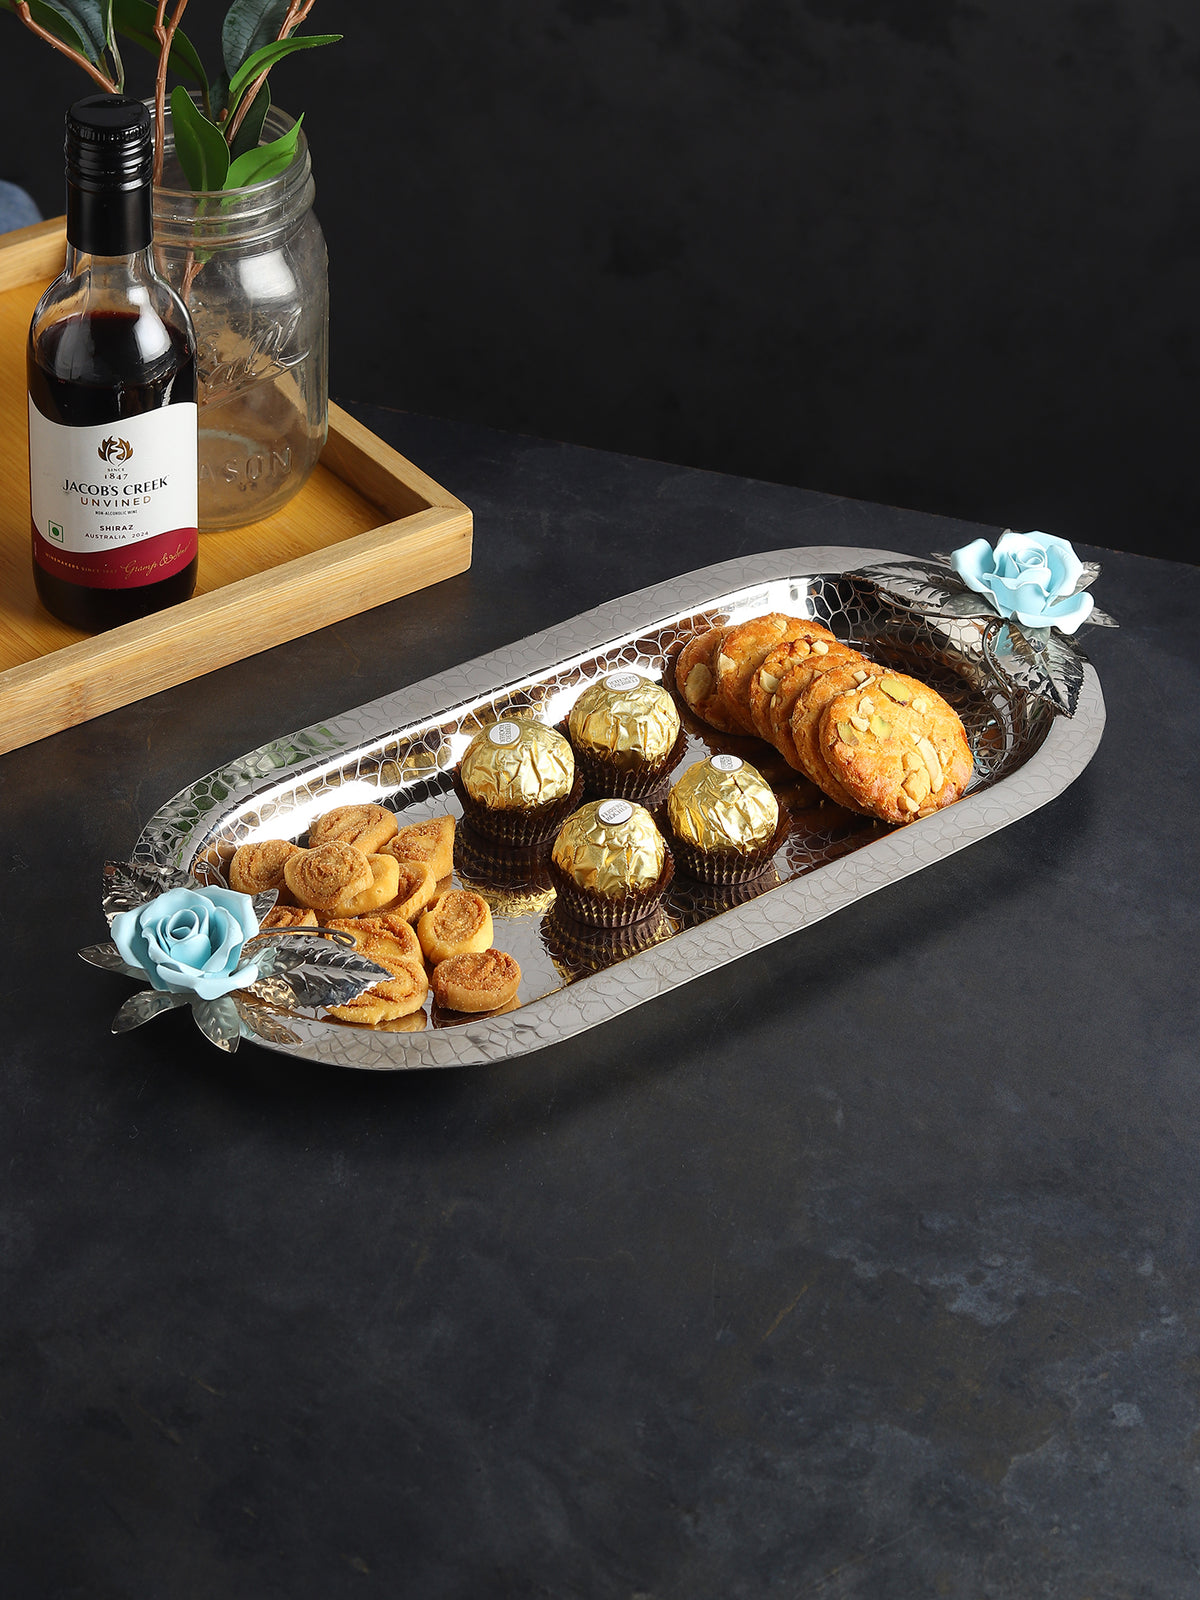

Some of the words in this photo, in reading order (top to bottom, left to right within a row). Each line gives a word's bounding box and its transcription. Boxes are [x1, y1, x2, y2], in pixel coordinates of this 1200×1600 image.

[200, 448, 293, 483] ASON
[63, 479, 119, 496] JACOB'S
[123, 475, 168, 496] CREEK
[80, 495, 152, 507] UNVINED
